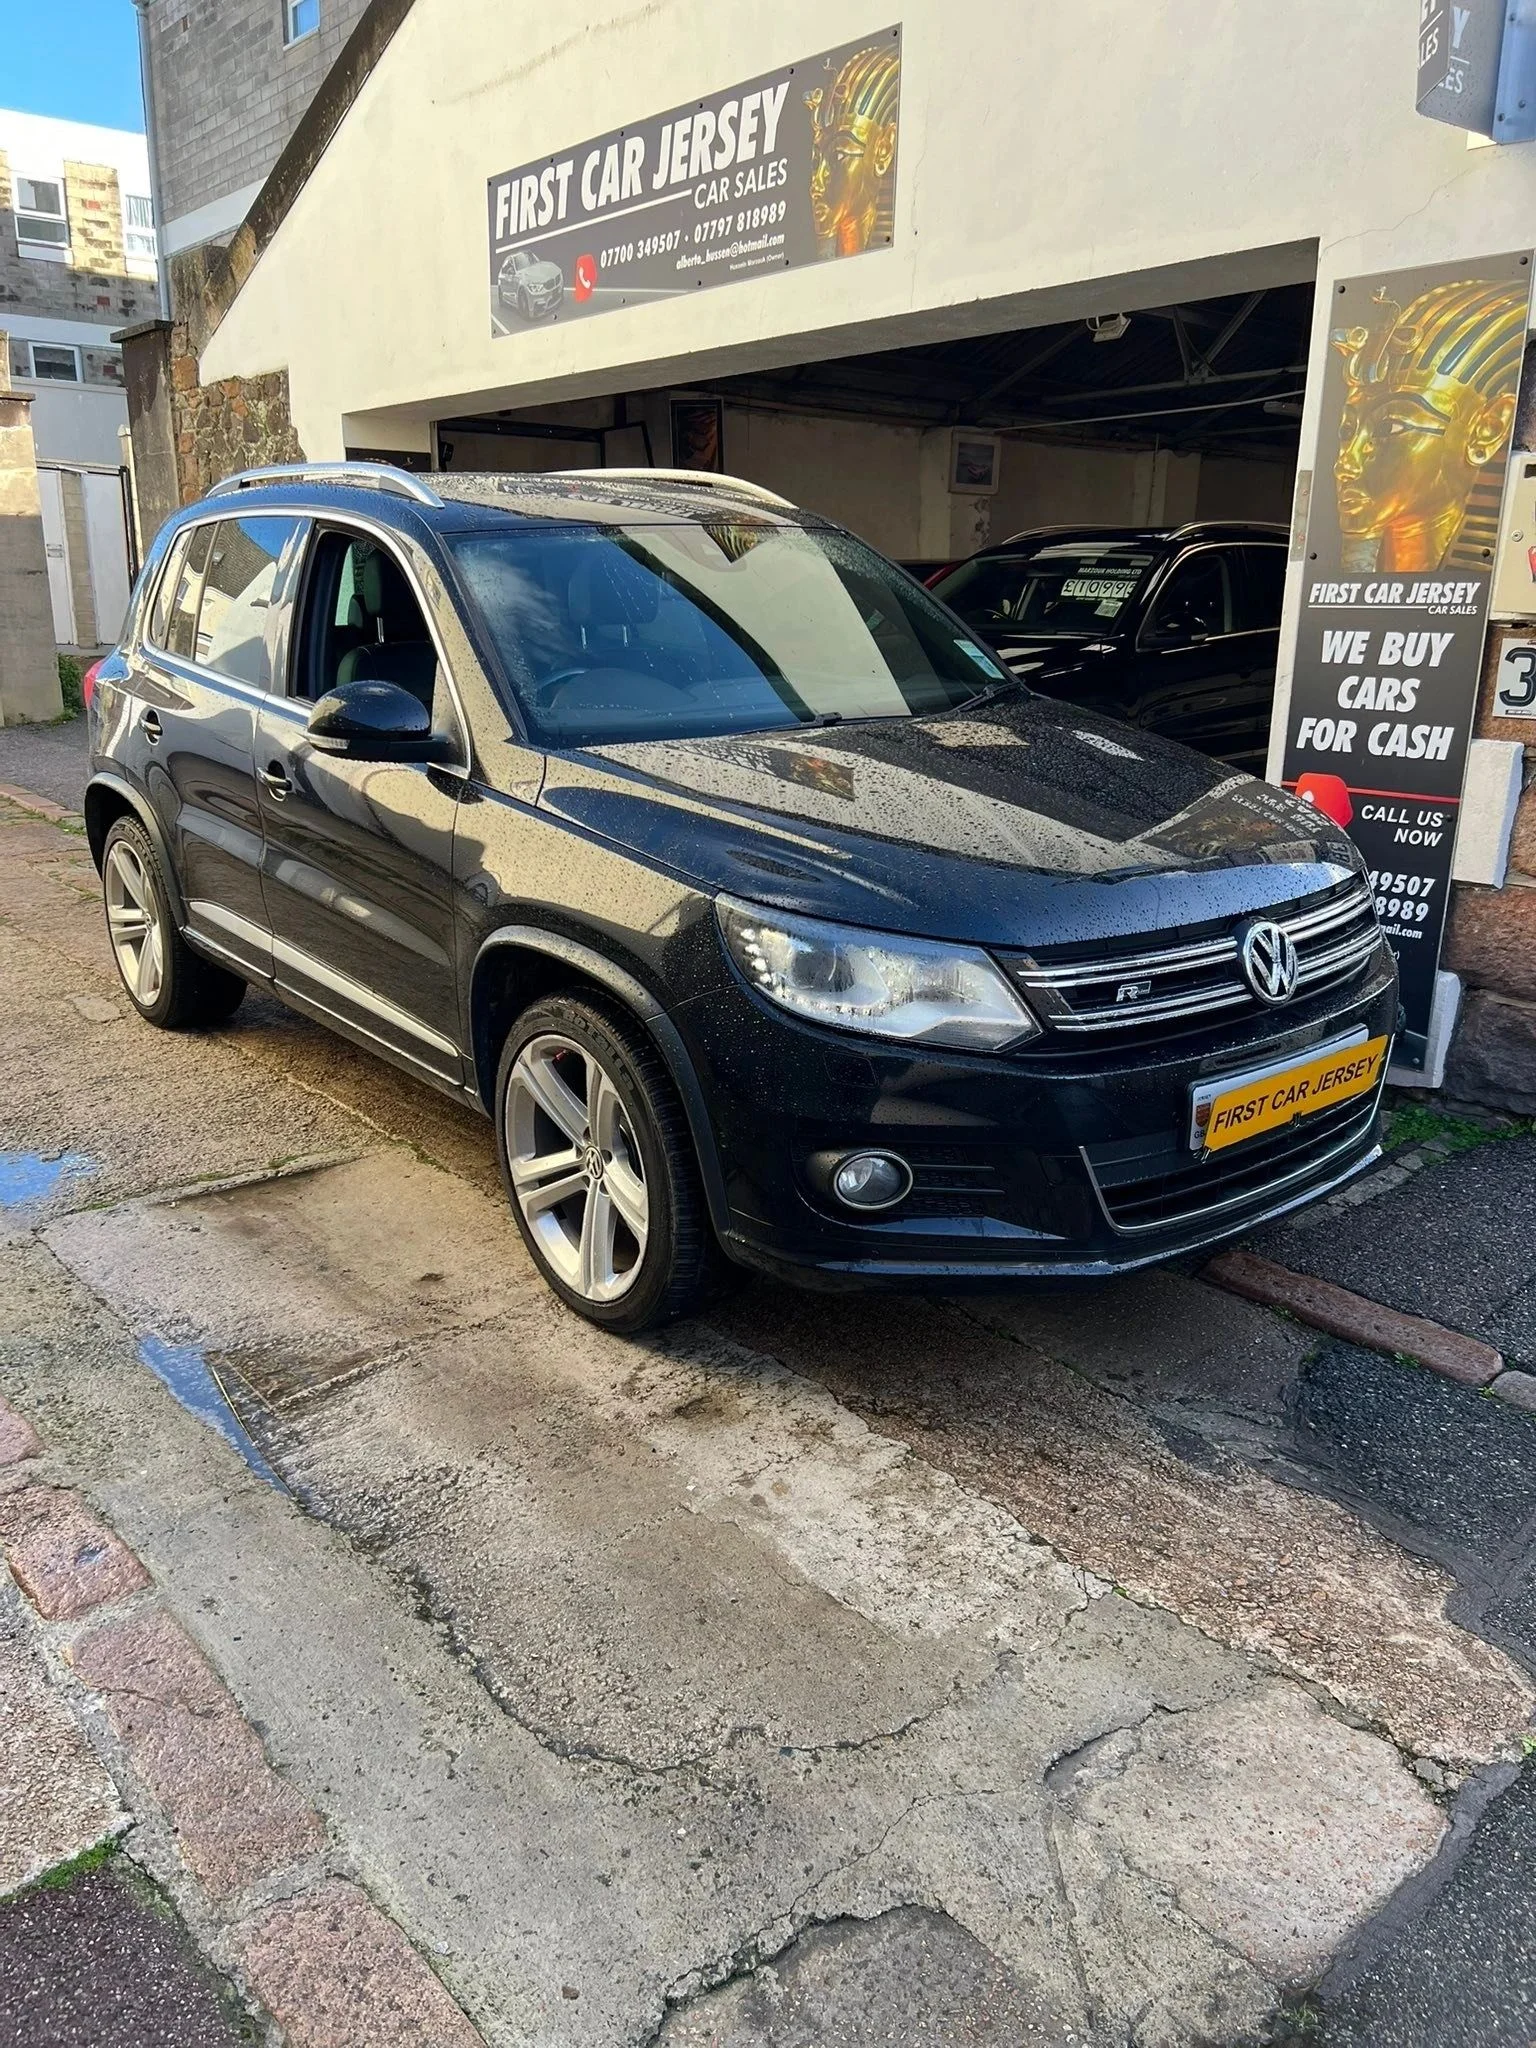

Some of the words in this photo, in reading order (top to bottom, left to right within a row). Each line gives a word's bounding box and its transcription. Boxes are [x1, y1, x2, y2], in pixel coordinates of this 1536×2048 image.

[495, 159, 574, 240] FIRST
[581, 135, 645, 211] CAR
[652, 81, 791, 190] JERSEY
[694, 176, 730, 209] CAR
[734, 157, 788, 199] SALES
[600, 242, 634, 269] 07700
[636, 229, 682, 260] 349507
[694, 214, 734, 244] 07797
[736, 200, 787, 233] 818989
[1309, 582, 1362, 604] FIRST
[1364, 582, 1404, 604] CAR
[1405, 581, 1482, 604] JERSEY
[1428, 605, 1448, 615] CAR
[1449, 605, 1478, 615] SALES
[1321, 630, 1371, 665] WE
[1378, 631, 1455, 667] BUY
[1337, 675, 1422, 713] CARS
[1296, 717, 1358, 753] FOR
[1367, 722, 1455, 761] CASH
[1361, 804, 1411, 825] CALL
[1417, 810, 1445, 828] US
[1394, 827, 1443, 847] NOW
[1368, 870, 1437, 898] 49507
[1375, 895, 1430, 923] 8989
[1213, 1094, 1269, 1133] FIRST
[1271, 1080, 1310, 1111] CAR
[1312, 1053, 1379, 1095] JERSEY
